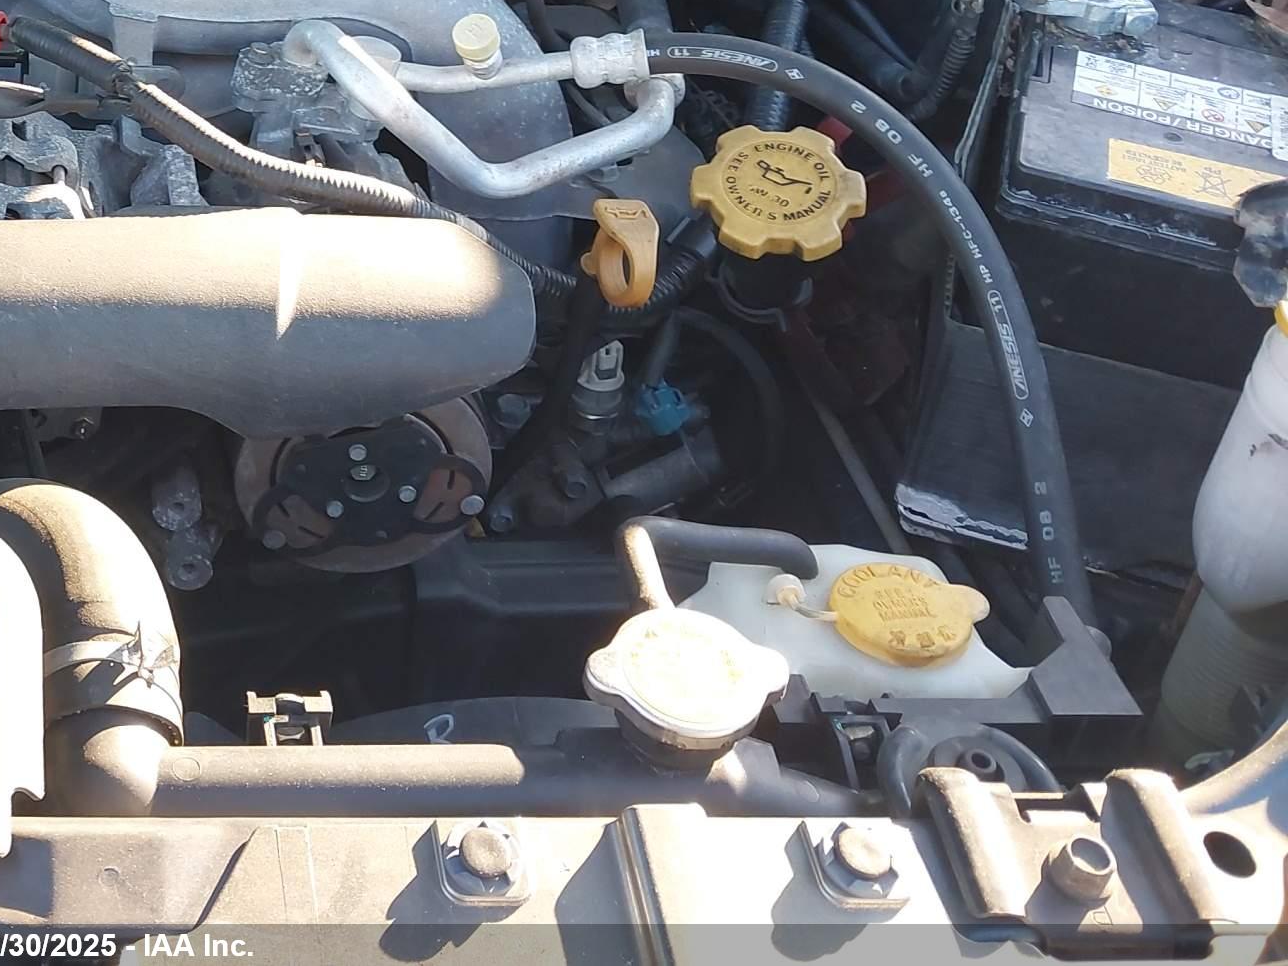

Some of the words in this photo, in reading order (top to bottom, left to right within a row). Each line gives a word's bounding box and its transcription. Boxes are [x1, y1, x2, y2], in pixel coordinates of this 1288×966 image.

[849, 100, 867, 114] 2
[1093, 98, 1171, 126] POISON
[1186, 121, 1272, 148] DANGER
[727, 151, 749, 171] SEE
[754, 143, 816, 161] ENGINE
[813, 162, 831, 182] OIL
[908, 153, 934, 178] HF
[726, 176, 777, 221] OWNERS
[783, 190, 832, 221] MANUAL
[979, 264, 993, 284] HP
[1034, 481, 1047, 495] 2
